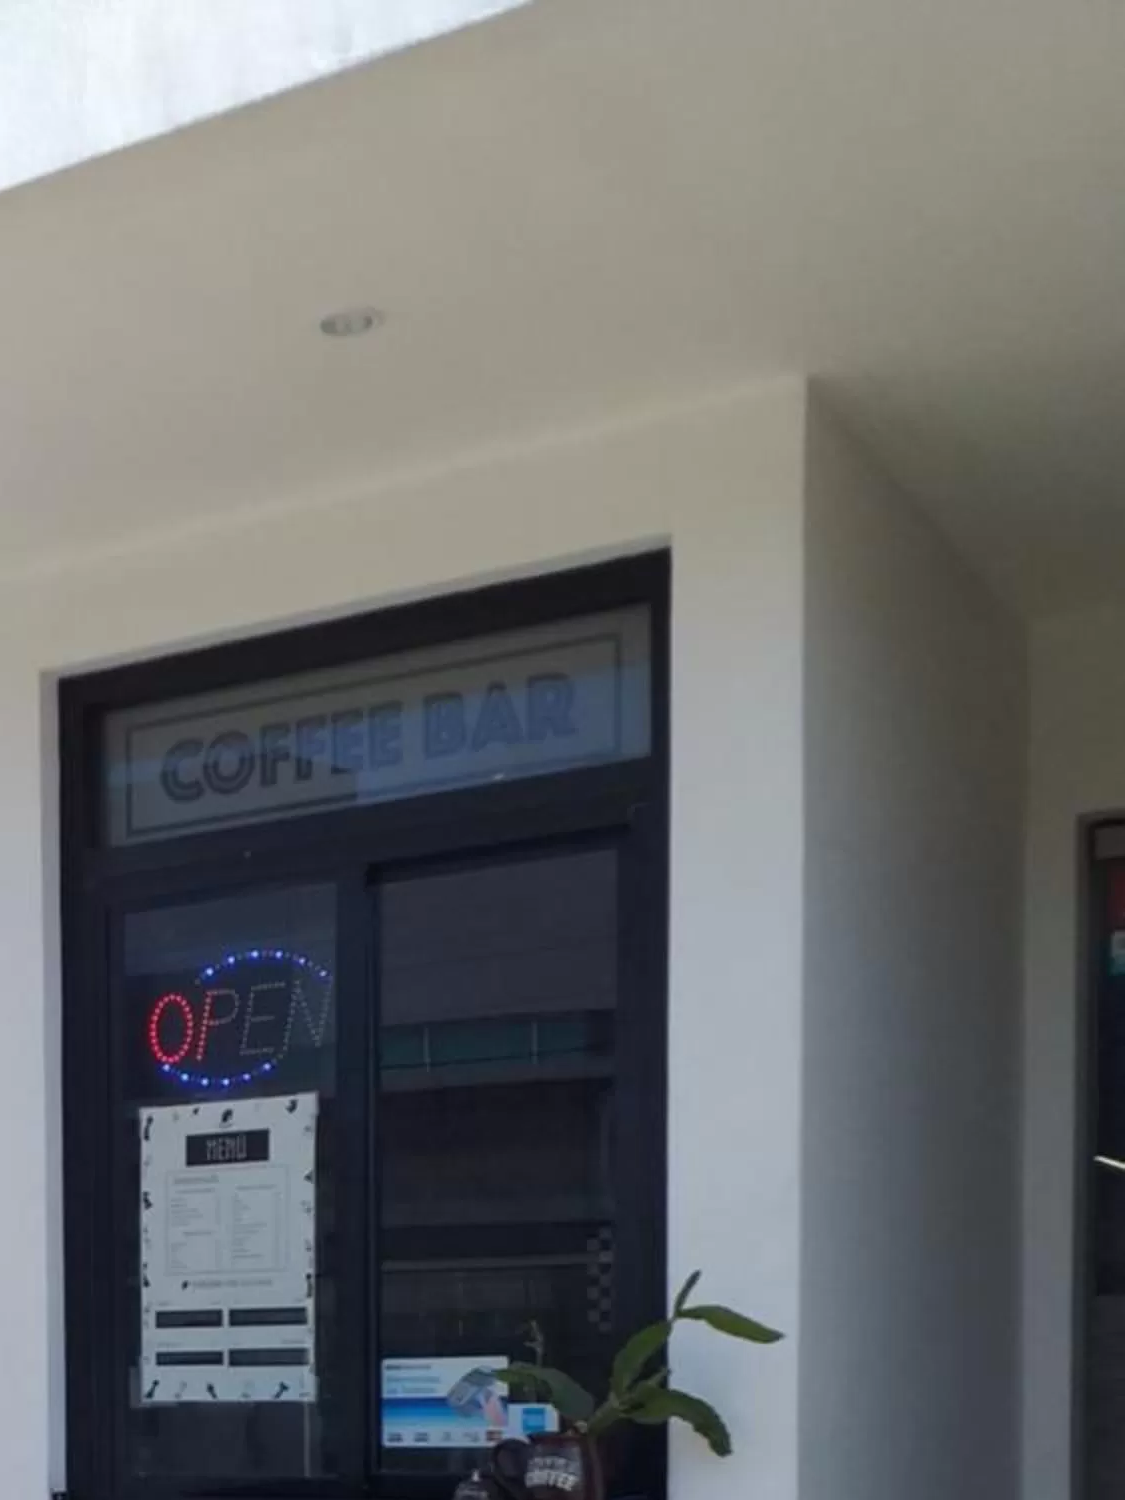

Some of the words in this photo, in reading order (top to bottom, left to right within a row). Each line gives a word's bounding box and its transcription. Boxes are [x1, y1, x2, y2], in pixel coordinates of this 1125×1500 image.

[160, 700, 404, 803] COFFEE
[423, 671, 577, 760] BAR
[148, 980, 331, 1063] OPEN
[206, 1135, 248, 1161] MENU
